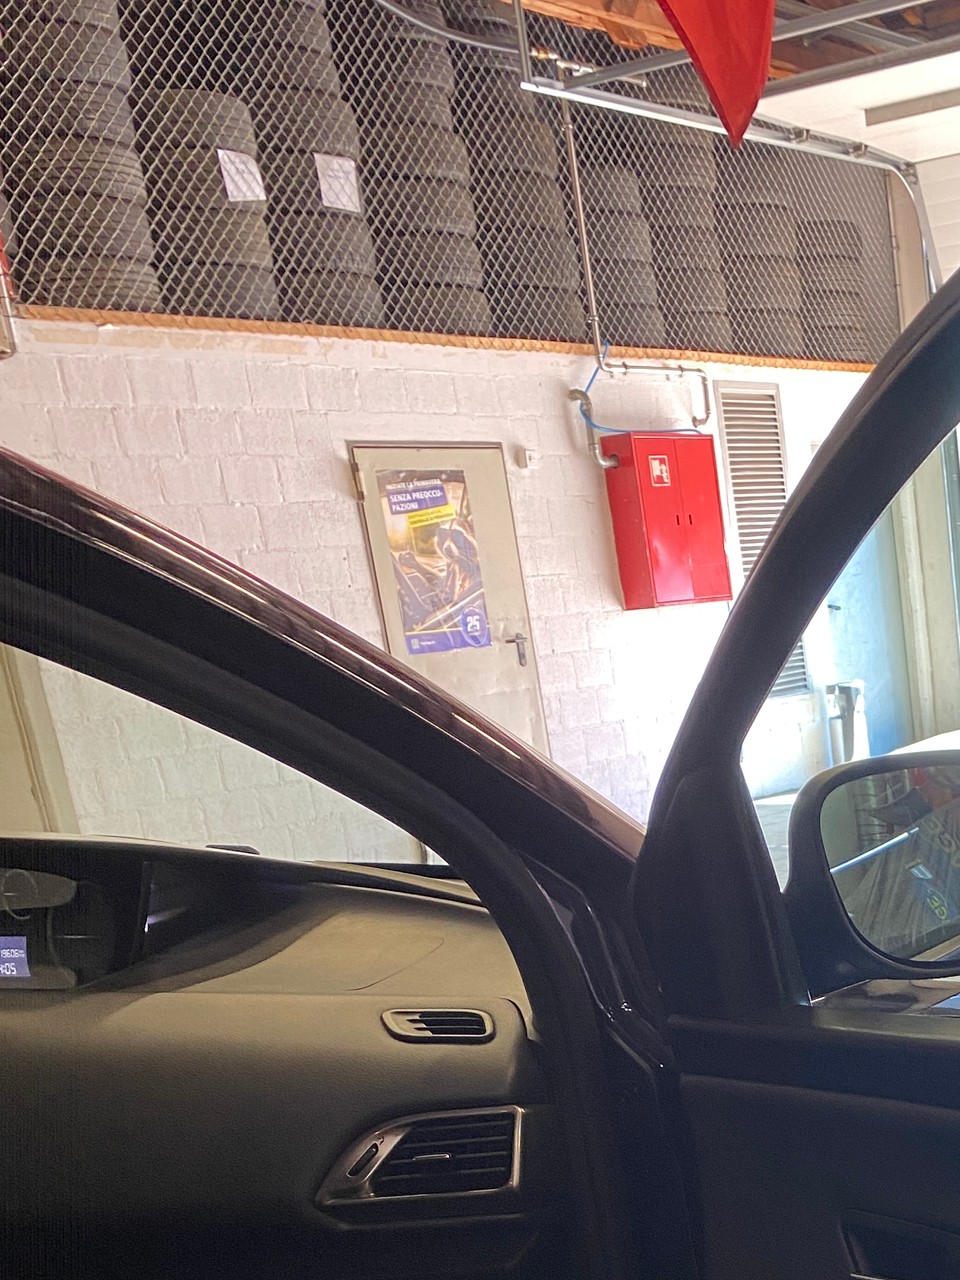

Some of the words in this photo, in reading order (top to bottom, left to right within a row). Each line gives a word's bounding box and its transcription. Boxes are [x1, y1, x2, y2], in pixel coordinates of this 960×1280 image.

[390, 493, 411, 502] SENZA
[412, 489, 443, 500] PREOCCU-
[392, 502, 418, 512] PAZIONI
[467, 615, 480, 632] 25
